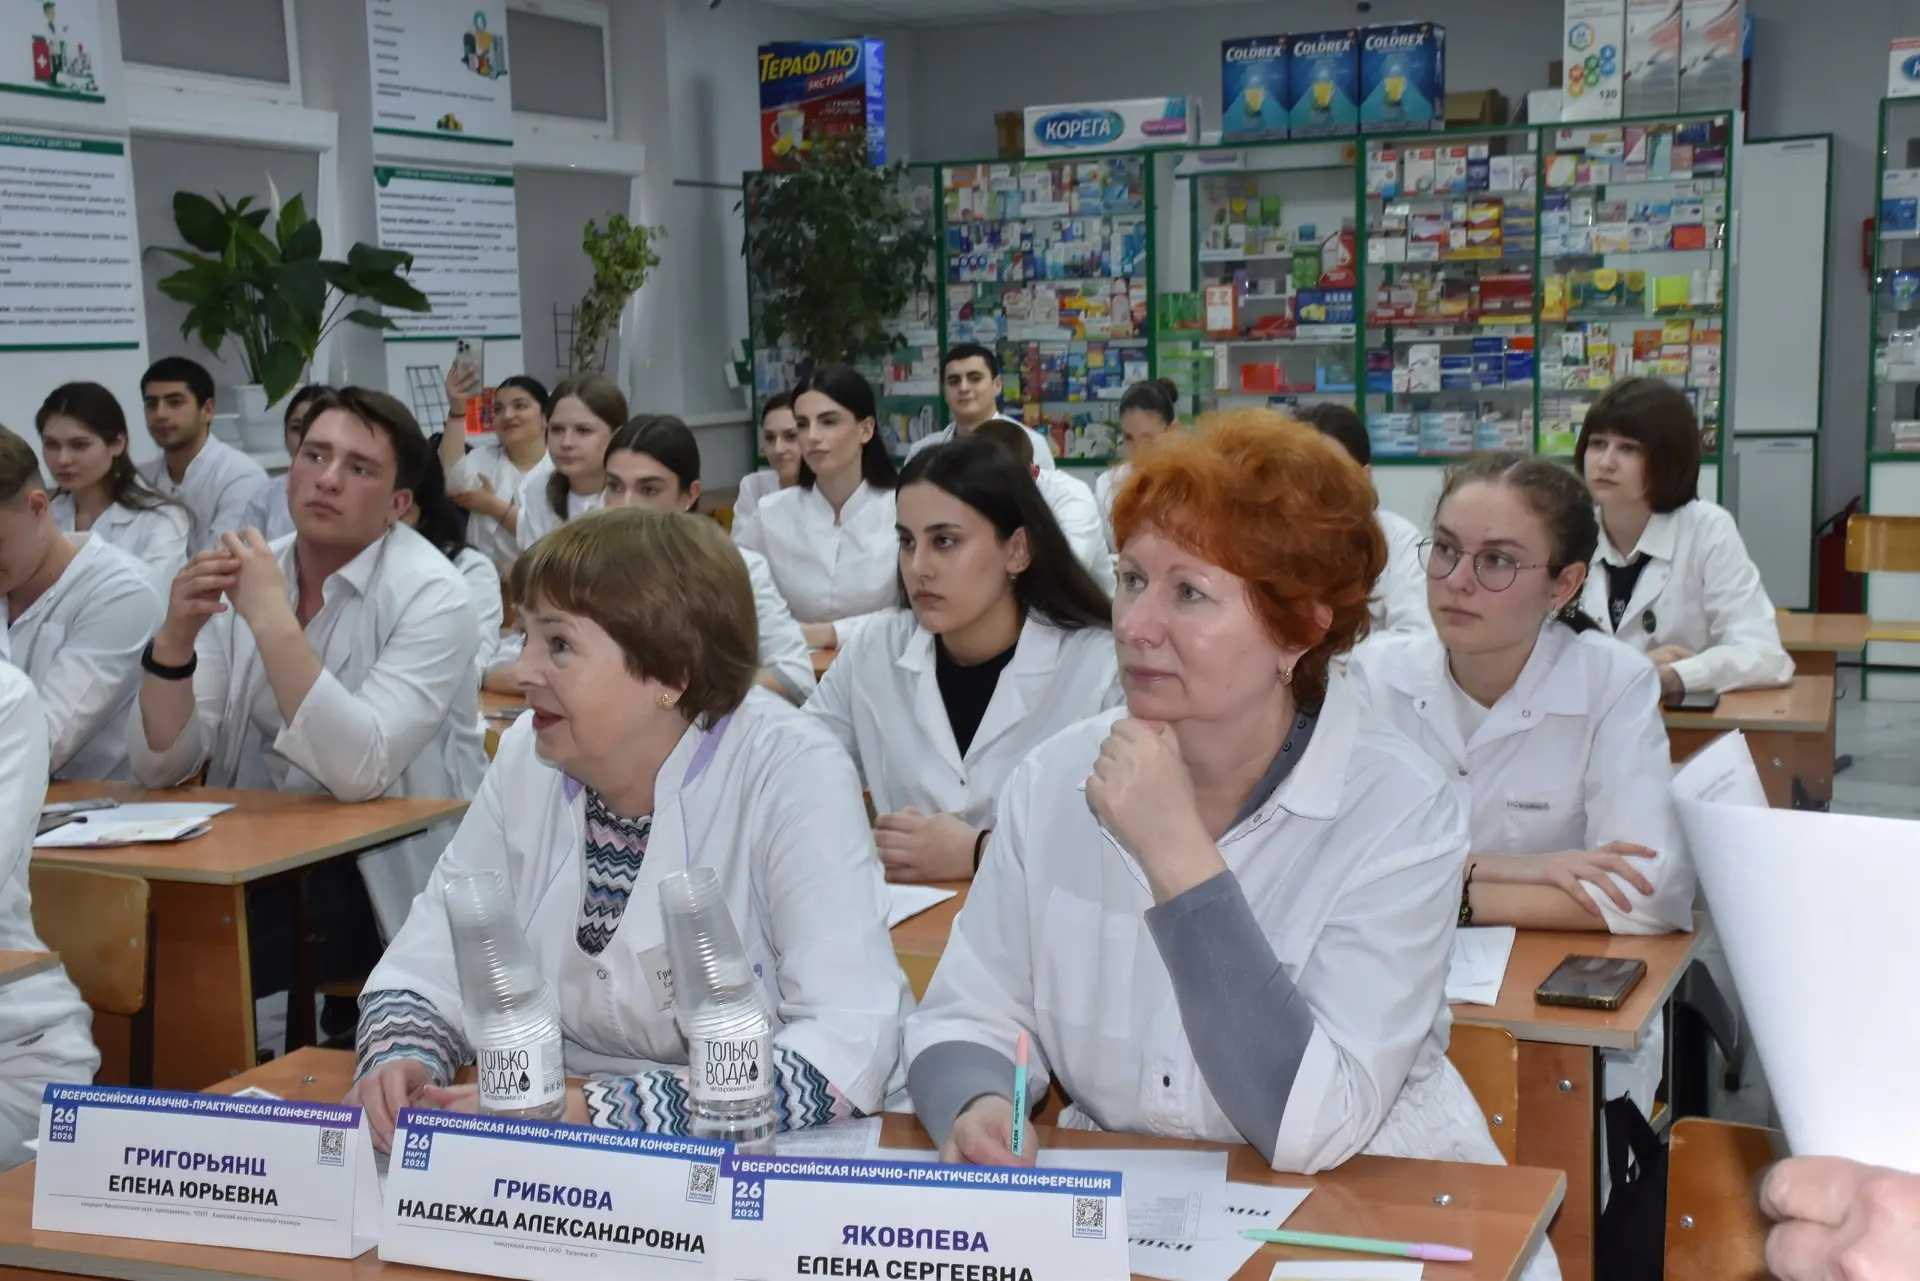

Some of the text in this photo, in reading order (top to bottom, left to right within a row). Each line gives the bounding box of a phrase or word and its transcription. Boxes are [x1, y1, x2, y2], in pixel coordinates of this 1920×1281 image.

[1294, 39, 1351, 58] COLDREX
[1365, 33, 1424, 50] COLDREX
[1226, 45, 1282, 62] COLDREX
[760, 47, 854, 83] ТЕРАФЛЮ
[807, 72, 845, 92] ЭКСТРА
[1045, 117, 1111, 141] КОРЕГА
[480, 1049, 529, 1071] ТОЛЬКО
[704, 1040, 758, 1062] ТОЛЬКО
[481, 1070, 519, 1094] ВОДА
[705, 1061, 749, 1085] ВОДА
[52, 1089, 353, 1123] V ВСЕРОССИЙСКАЯ НАУЧНО-ПРАКТИЧЕСКАЯ КОНФЕРЕНЦИЯ
[53, 1107, 76, 1124] 26
[52, 1124, 73, 1133] МАРТА
[52, 1131, 73, 1141] 2026
[407, 1114, 725, 1158] V ВСЕРОССИЙСКАЯ НАУЧНО-ПРАКТИЧЕСКАЯ КОНФЕРЕНЦИЯ
[407, 1133, 430, 1151] 26
[123, 1146, 267, 1177] ГРИГОРЬЯНЦ
[404, 1158, 426, 1169] 2026
[405, 1150, 427, 1159] МАРТА
[731, 1161, 1112, 1189] V ВСЕРОССИЙСКАЯ НАУЧНО-ПРАКТИЧЕСКАЯ КОНФЕРЕНЦИЯ
[108, 1174, 279, 1207] ЕЛЕНА ЮРЬЕВНА
[493, 1178, 613, 1211] ГРИБКОВА
[736, 1181, 762, 1199] 26
[734, 1200, 760, 1208] МАРТА
[734, 1208, 760, 1218] 2026
[397, 1198, 705, 1254] НАДЕЖДА АЛЕКСАНДРОВНА
[841, 1224, 989, 1253] ЯКОВЛЕВА
[797, 1255, 1034, 1281] ЕЛЕНА СЕРГЕЕВНА
